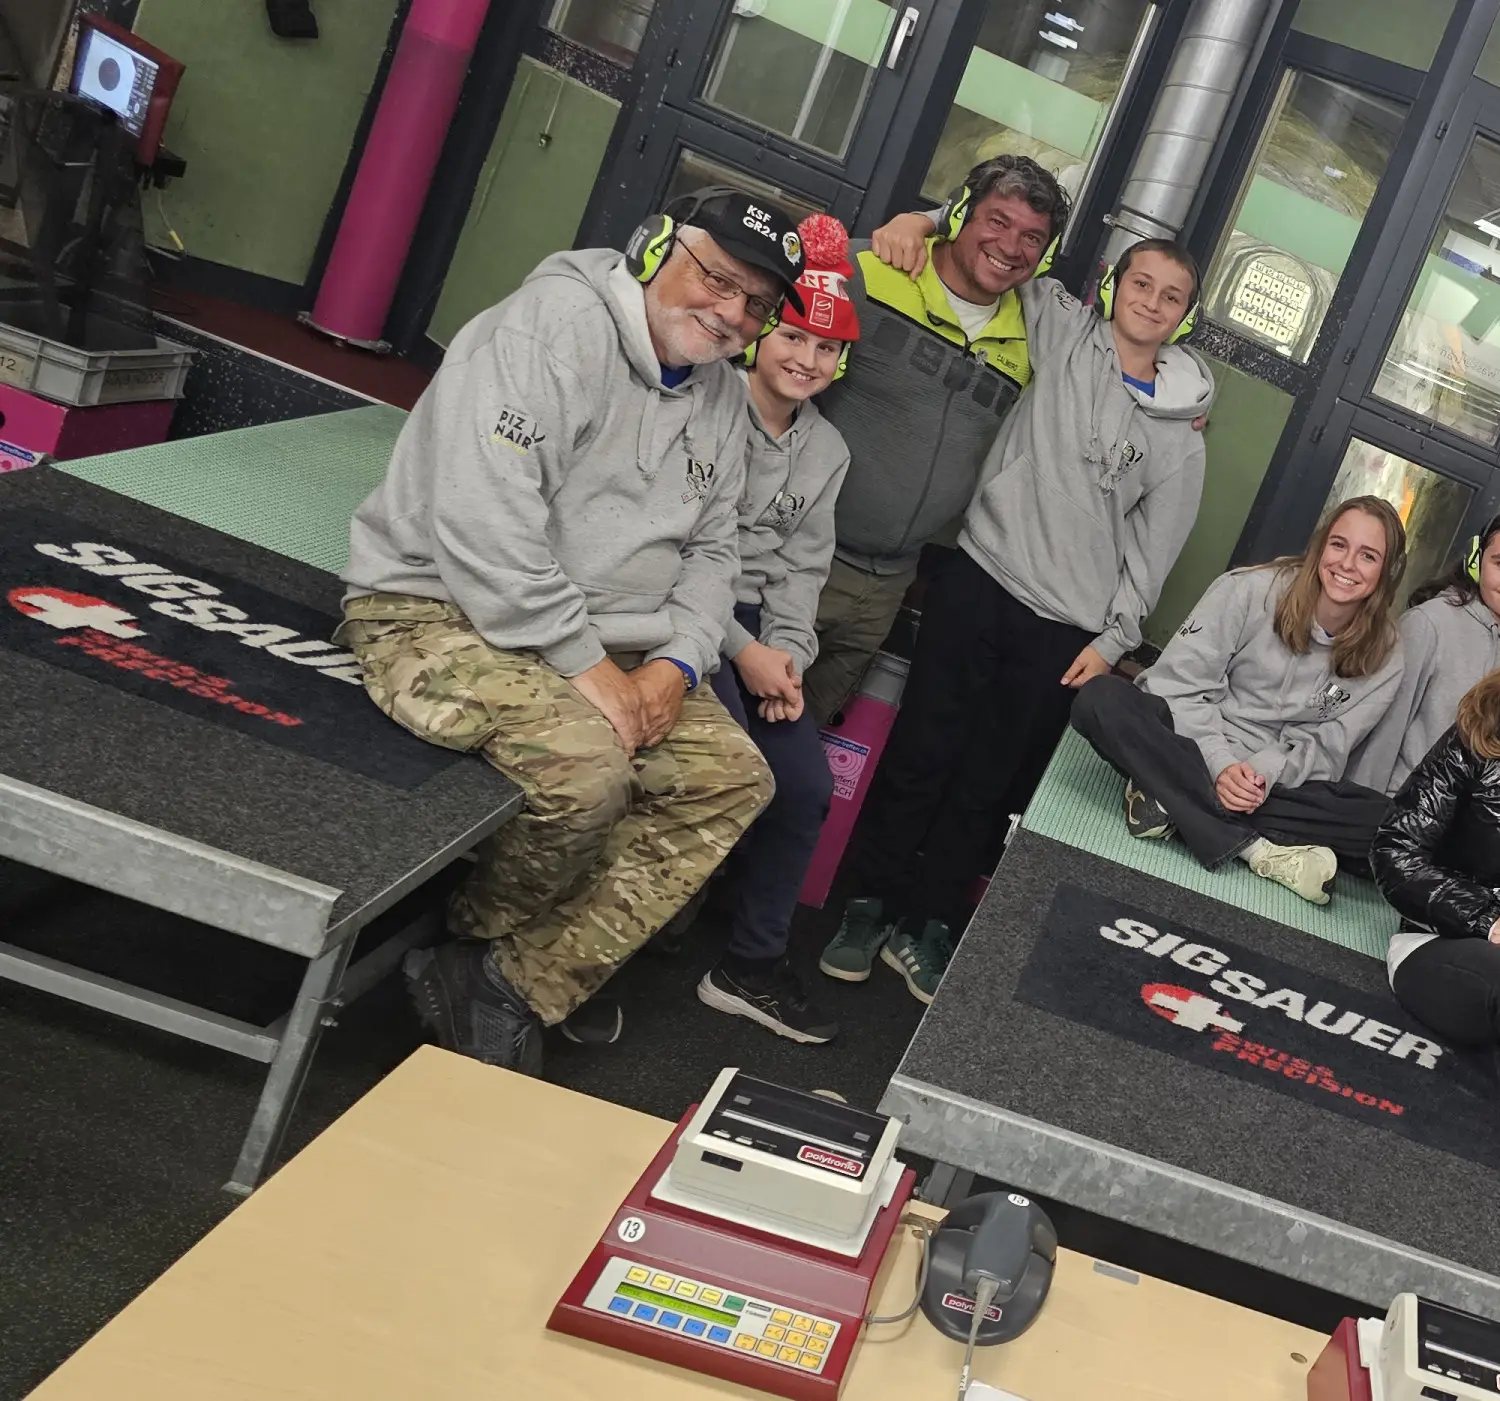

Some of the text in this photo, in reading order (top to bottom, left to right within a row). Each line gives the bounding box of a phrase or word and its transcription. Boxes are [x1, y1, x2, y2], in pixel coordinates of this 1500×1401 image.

[746, 205, 772, 222] KSF
[742, 217, 778, 242] GR24
[499, 410, 526, 430] PIZ
[494, 424, 531, 450] NAIR
[33, 541, 364, 685] SIG SAUE
[1099, 916, 1444, 1070] SIG SAUER
[1219, 1032, 1334, 1078] SWISS
[1212, 1041, 1404, 1115] PRECISION
[805, 1152, 856, 1171] polytronic
[621, 1218, 641, 1240] 13
